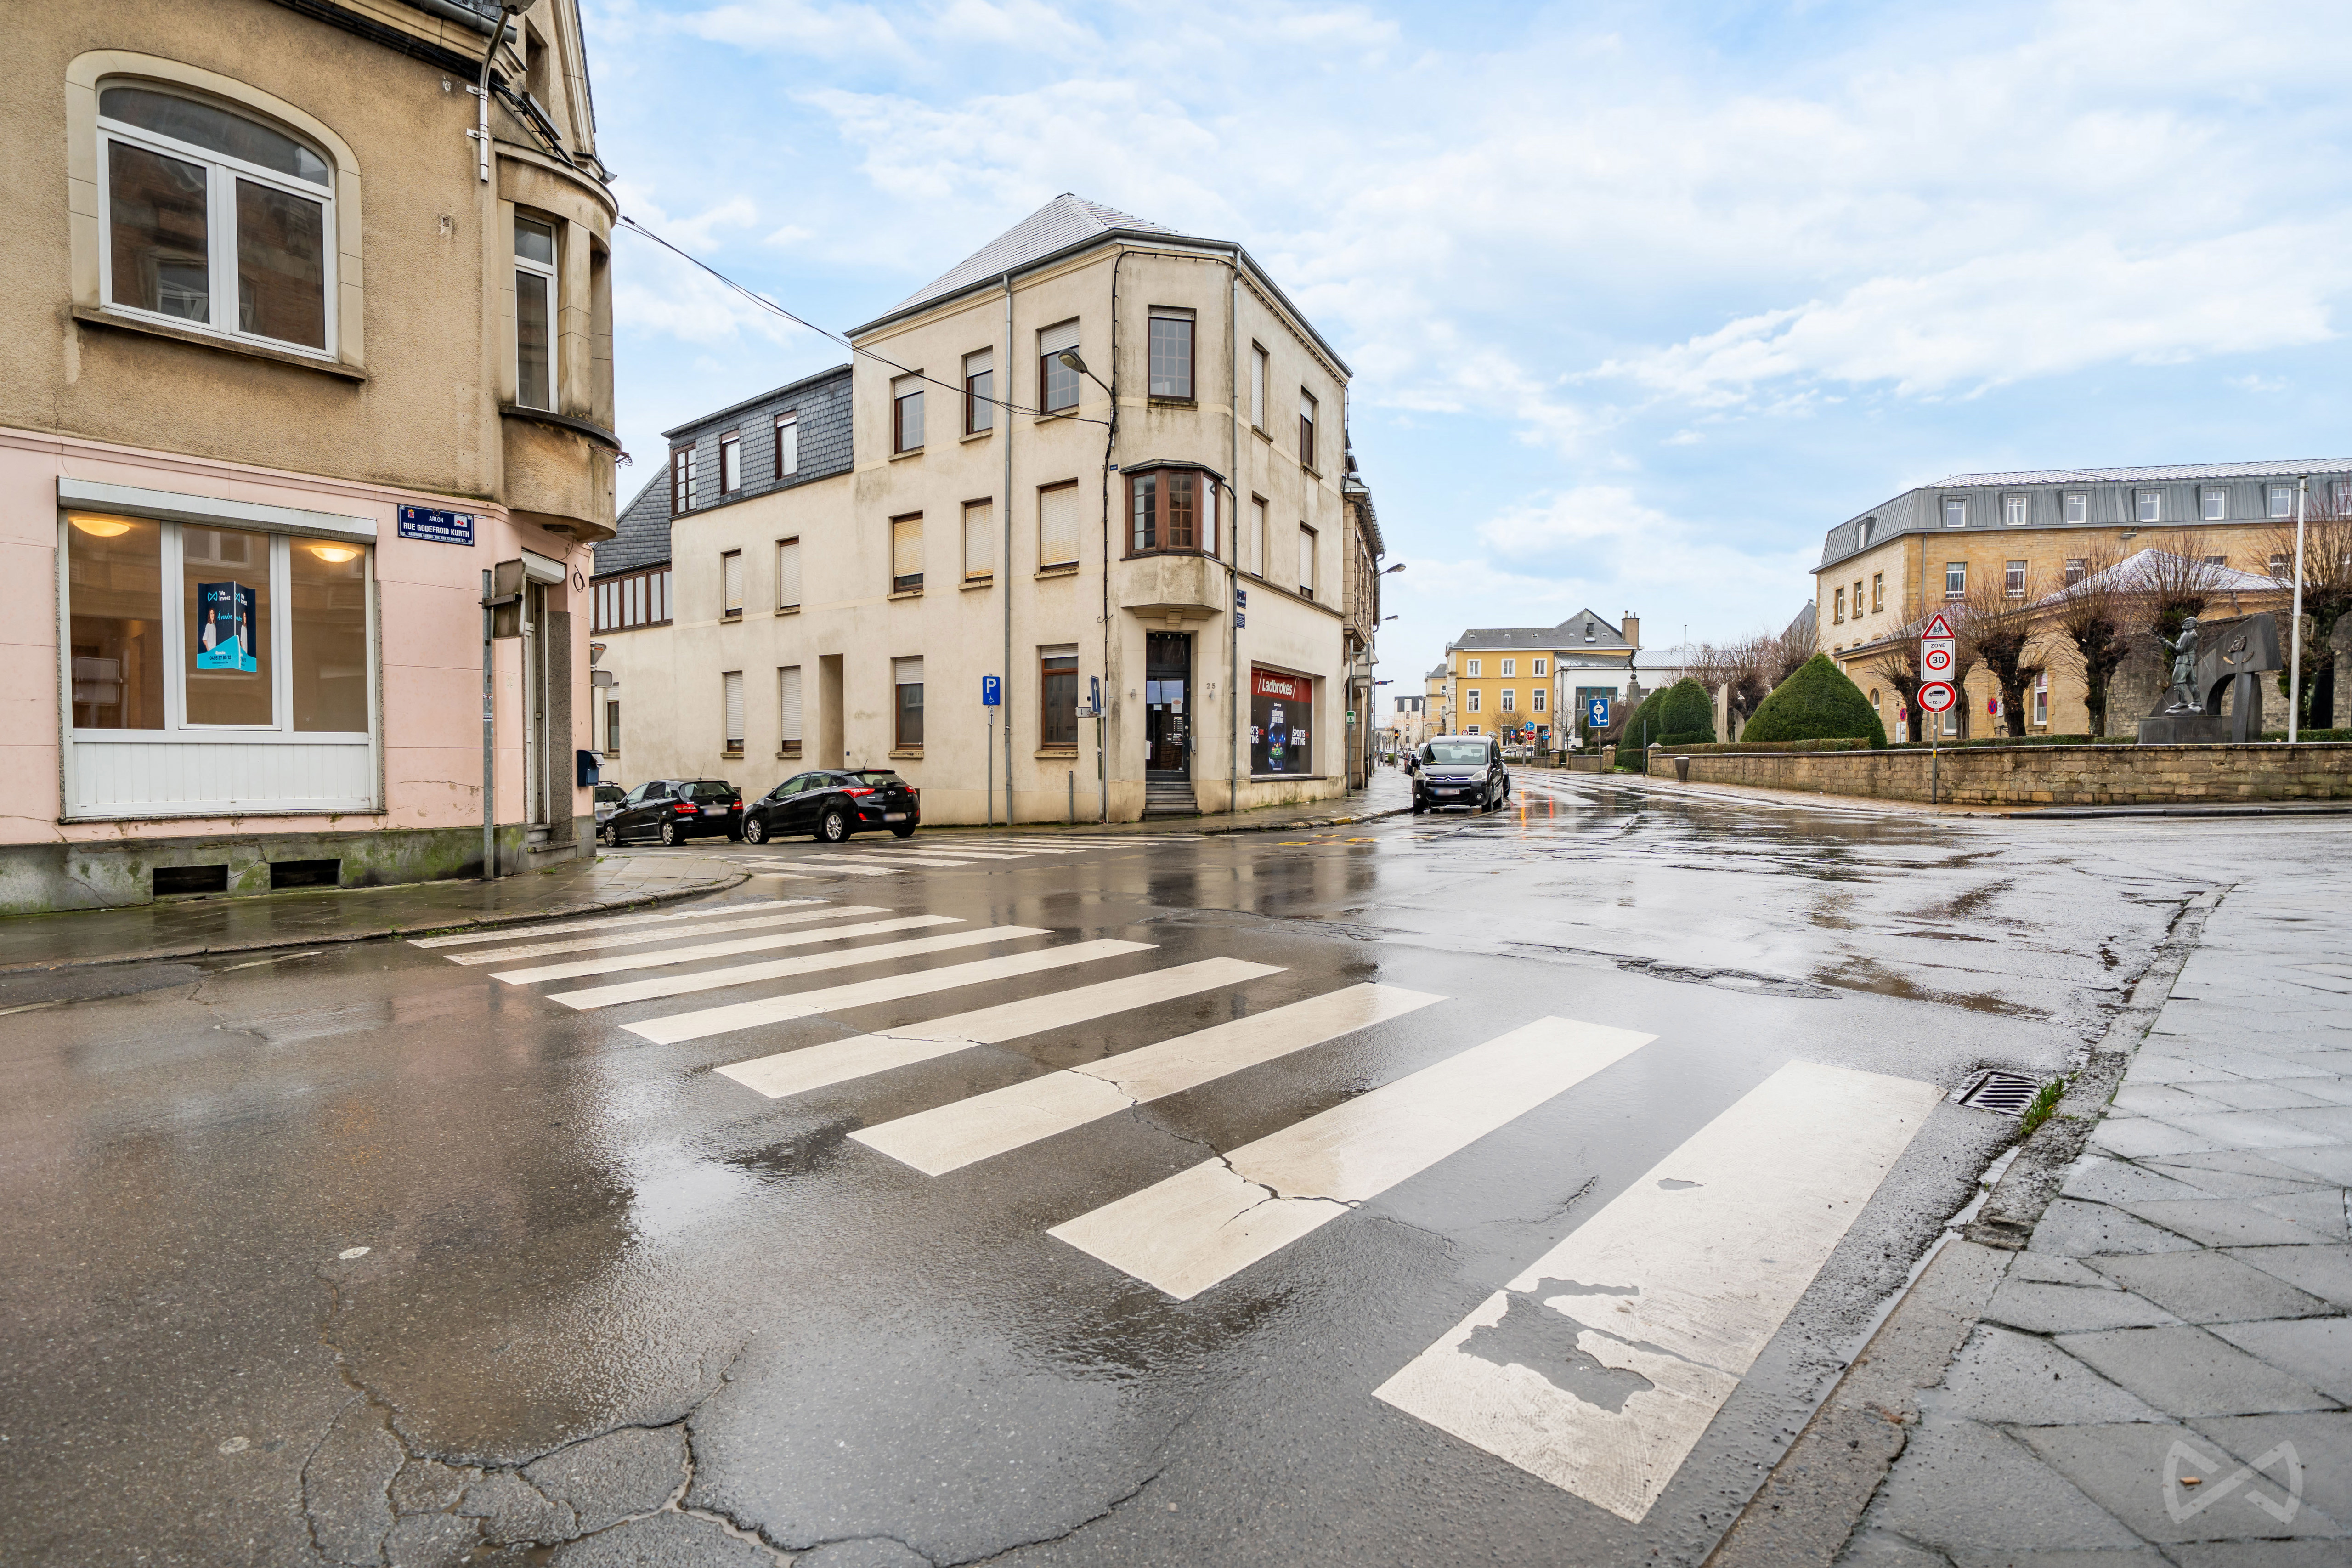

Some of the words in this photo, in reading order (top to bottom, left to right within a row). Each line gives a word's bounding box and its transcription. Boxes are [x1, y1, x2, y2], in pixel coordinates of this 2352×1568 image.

[403, 522, 416, 531] RUE
[417, 524, 449, 535] GODEFROID
[451, 529, 469, 538] KURTH
[217, 611, 220, 620] À
[986, 678, 996, 693] P
[1262, 678, 1293, 696] Ladbrokes
[1250, 726, 1259, 735] RTS
[1292, 729, 1305, 737] SPORTS
[1291, 737, 1306, 746] BETTING
